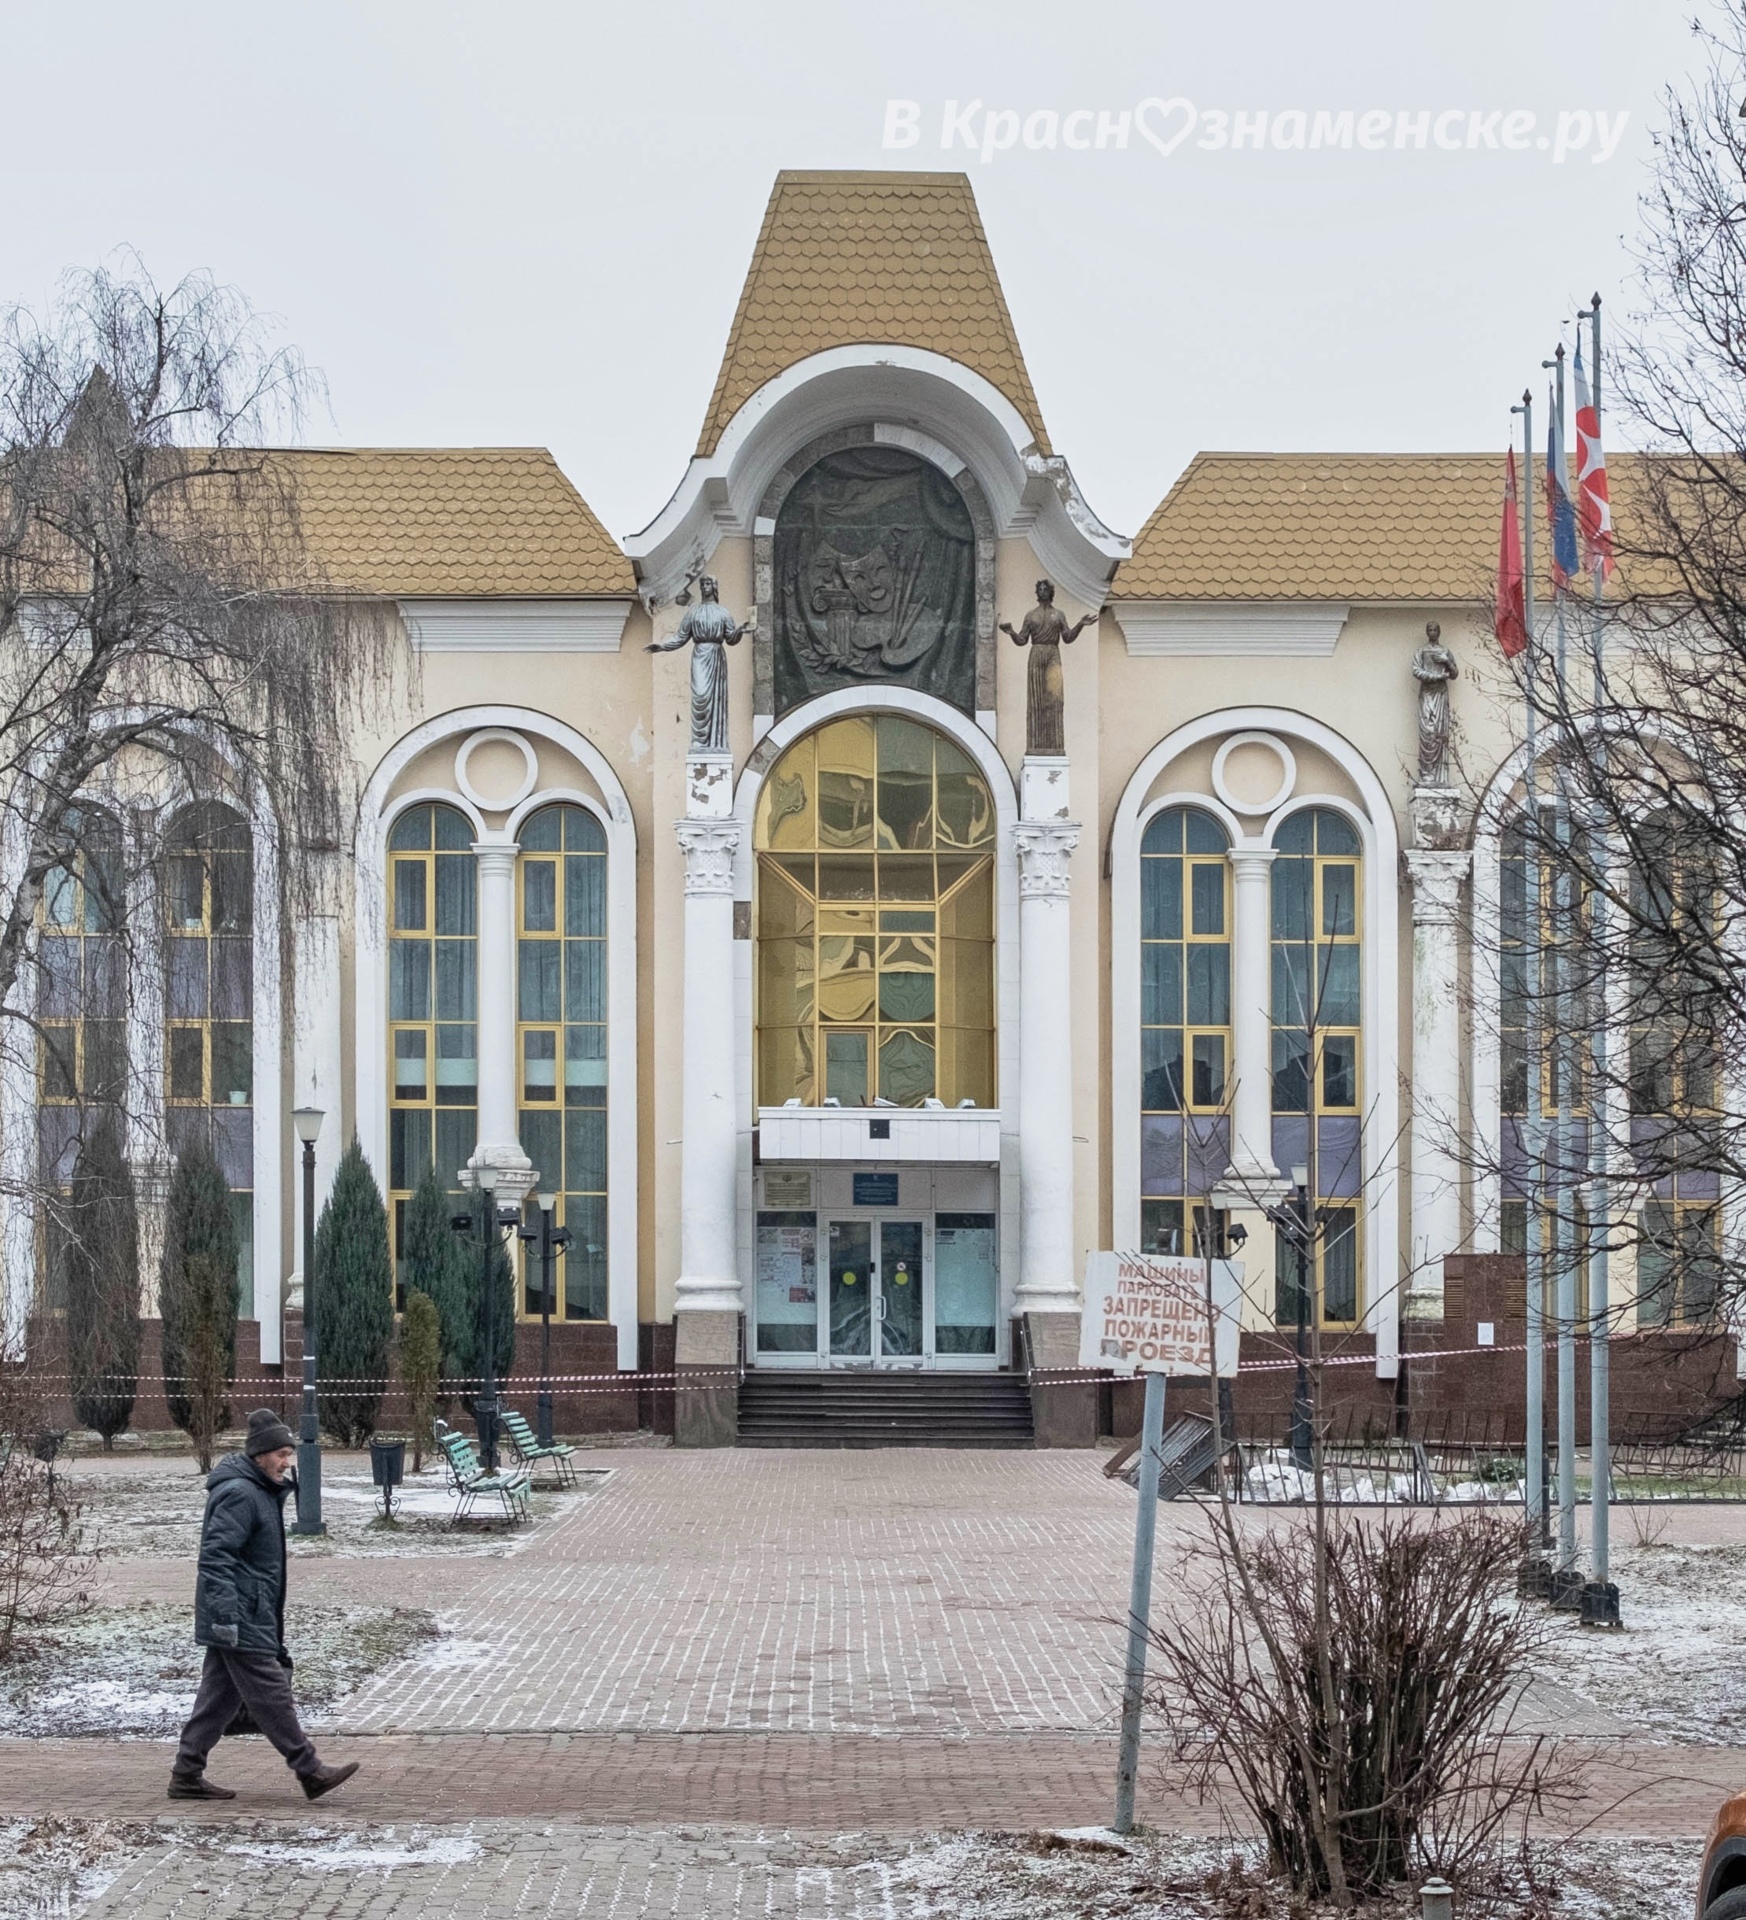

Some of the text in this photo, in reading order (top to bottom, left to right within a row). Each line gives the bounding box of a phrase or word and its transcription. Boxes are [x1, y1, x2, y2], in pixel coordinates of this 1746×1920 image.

[1118, 1264, 1205, 1284] МАШИНЫ
[1117, 1281, 1198, 1300] ПАРКОВАТЬ
[1103, 1296, 1221, 1324] ЗАПРЕЩЕНО
